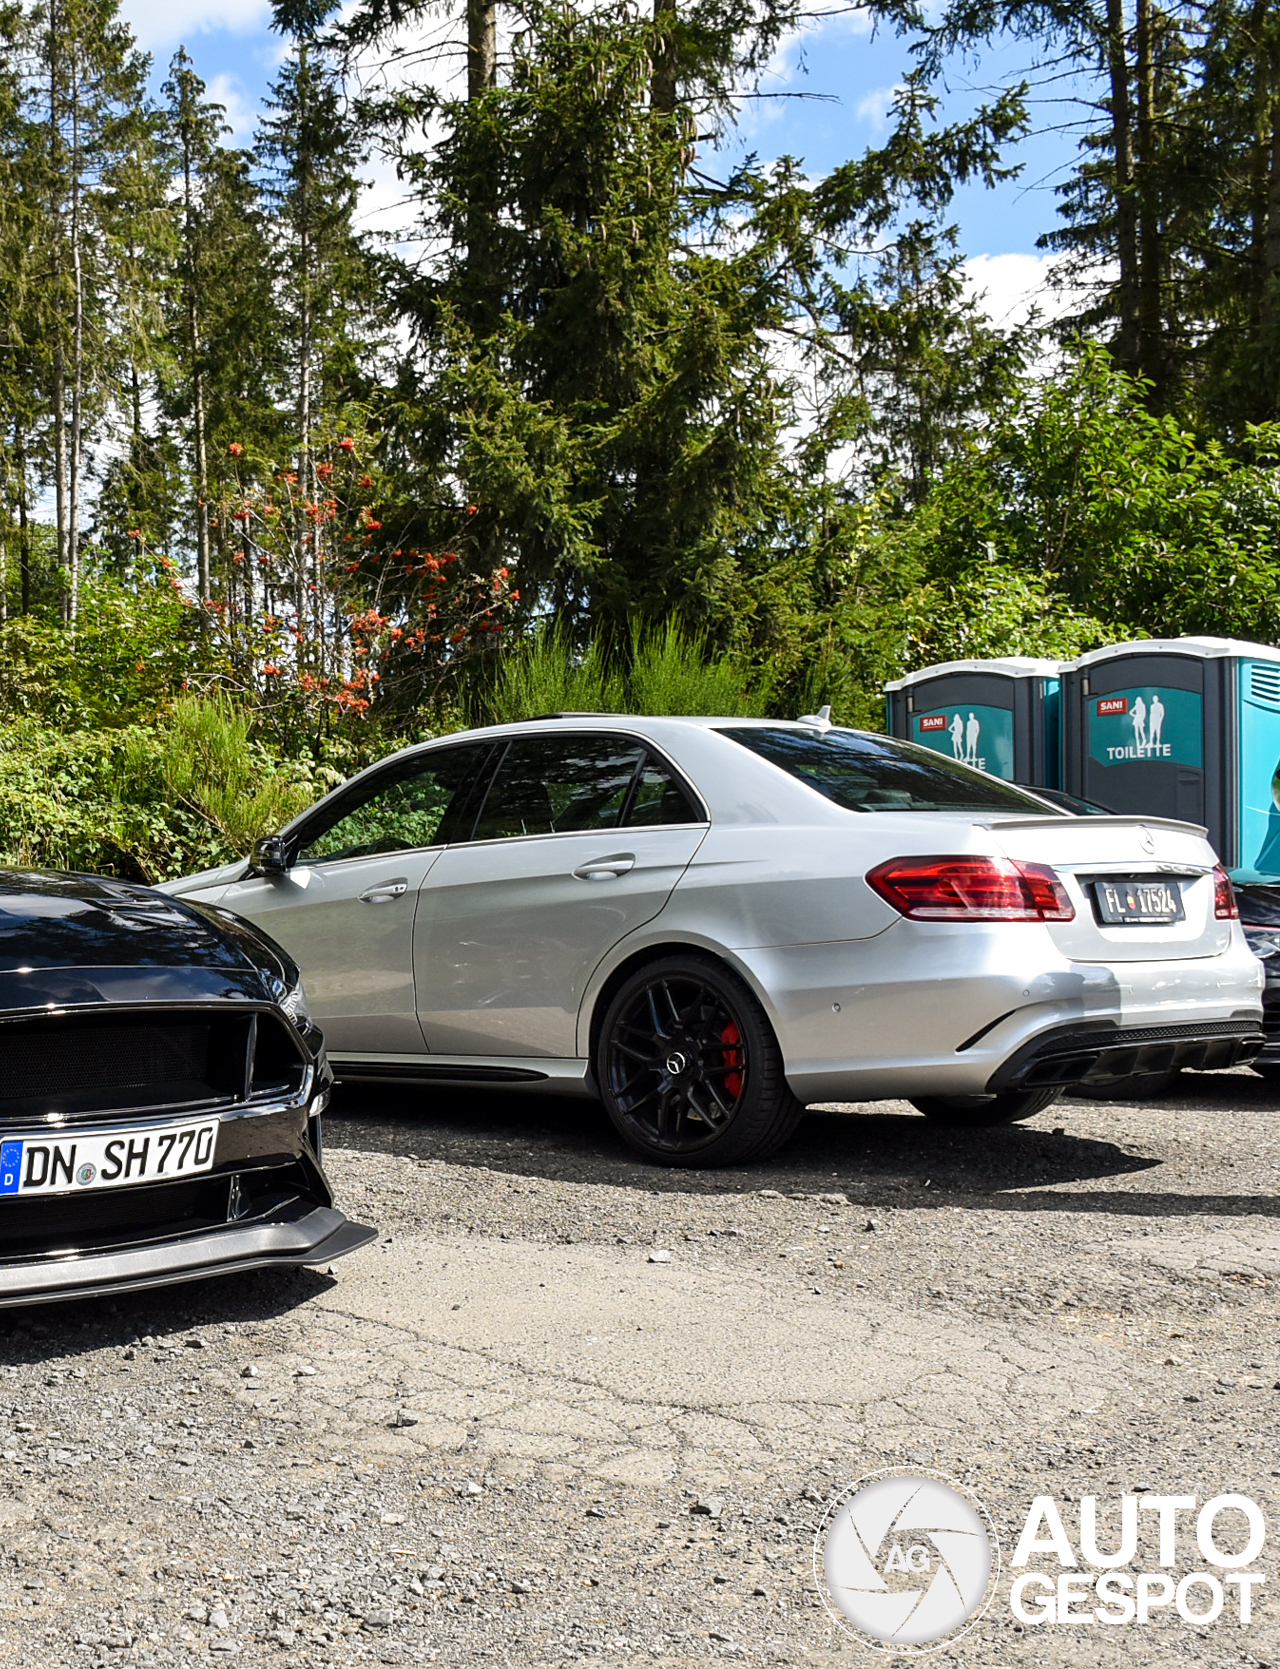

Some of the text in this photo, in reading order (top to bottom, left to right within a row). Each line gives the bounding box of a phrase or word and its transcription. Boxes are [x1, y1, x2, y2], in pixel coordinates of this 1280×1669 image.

[1100, 700, 1123, 711] SANI
[923, 717, 943, 727] SANI
[1107, 743, 1171, 760] TOILETTE
[1105, 888, 1177, 913] FL 17524
[22, 1144, 77, 1188] DN
[3, 1173, 13, 1186] D
